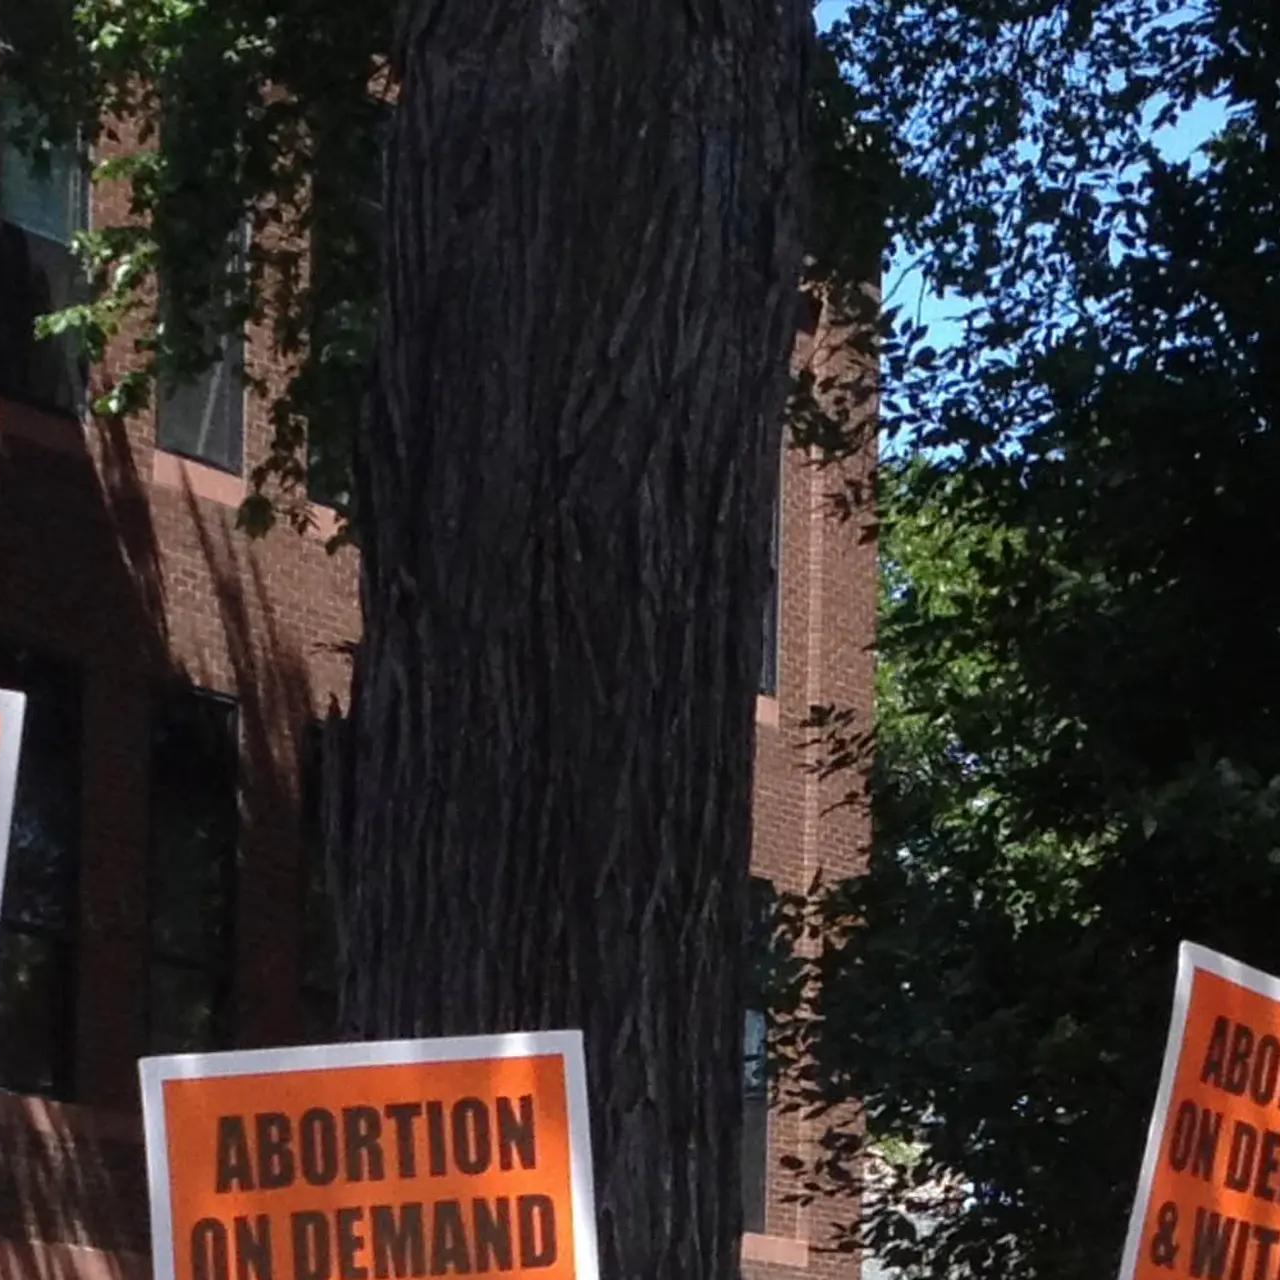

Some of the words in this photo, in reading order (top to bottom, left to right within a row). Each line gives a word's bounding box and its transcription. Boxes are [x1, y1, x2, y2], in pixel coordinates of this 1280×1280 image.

[215, 1093, 536, 1193] ABORTION
[1168, 1100, 1224, 1183] ON
[1150, 1201, 1180, 1269] &
